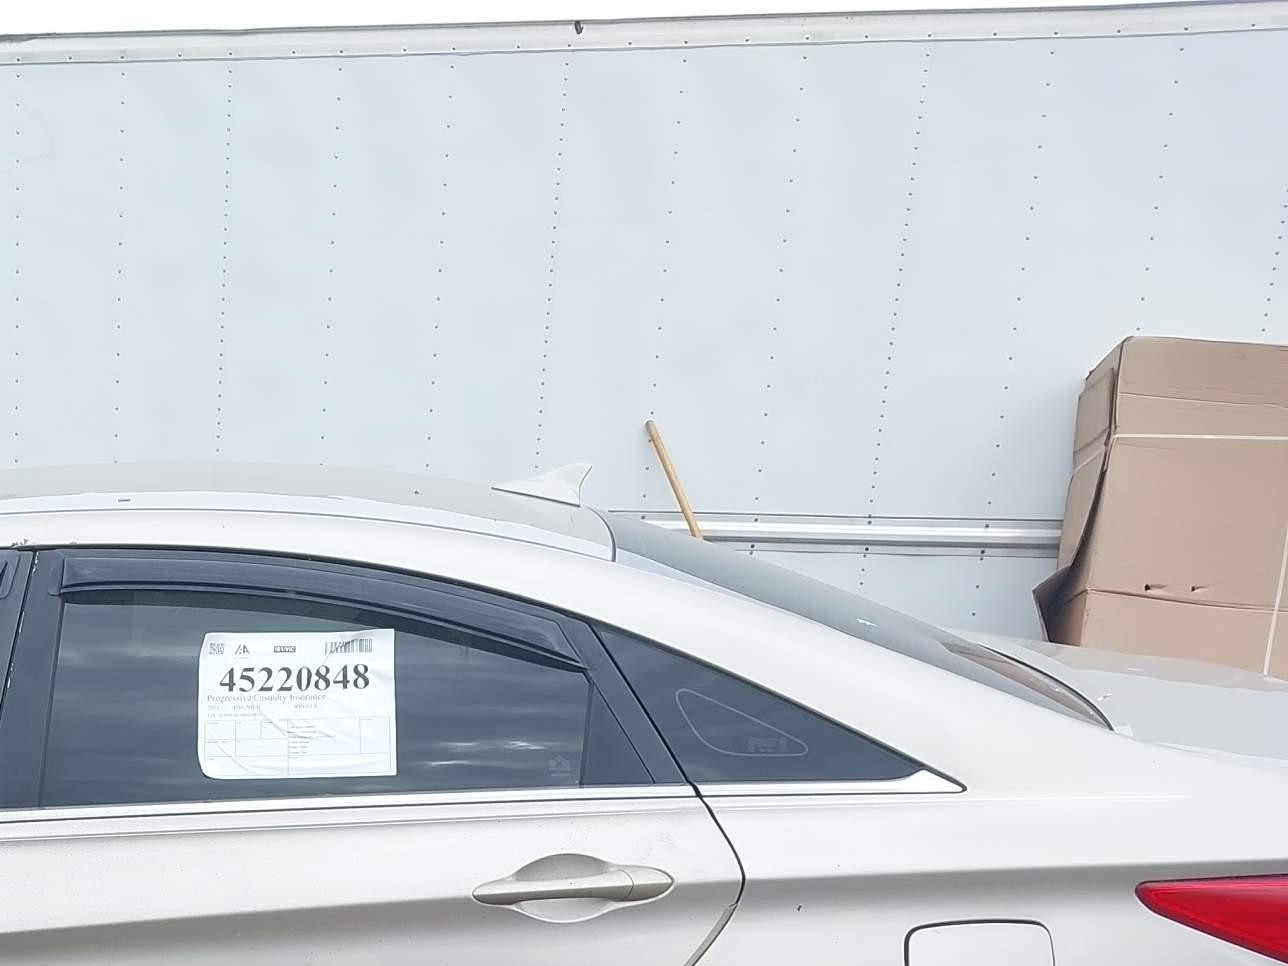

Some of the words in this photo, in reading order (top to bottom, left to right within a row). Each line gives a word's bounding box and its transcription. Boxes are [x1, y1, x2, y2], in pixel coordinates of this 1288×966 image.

[219, 663, 370, 692] 45220848
[207, 694, 252, 703] Progressive
[253, 693, 288, 703] Casualty
